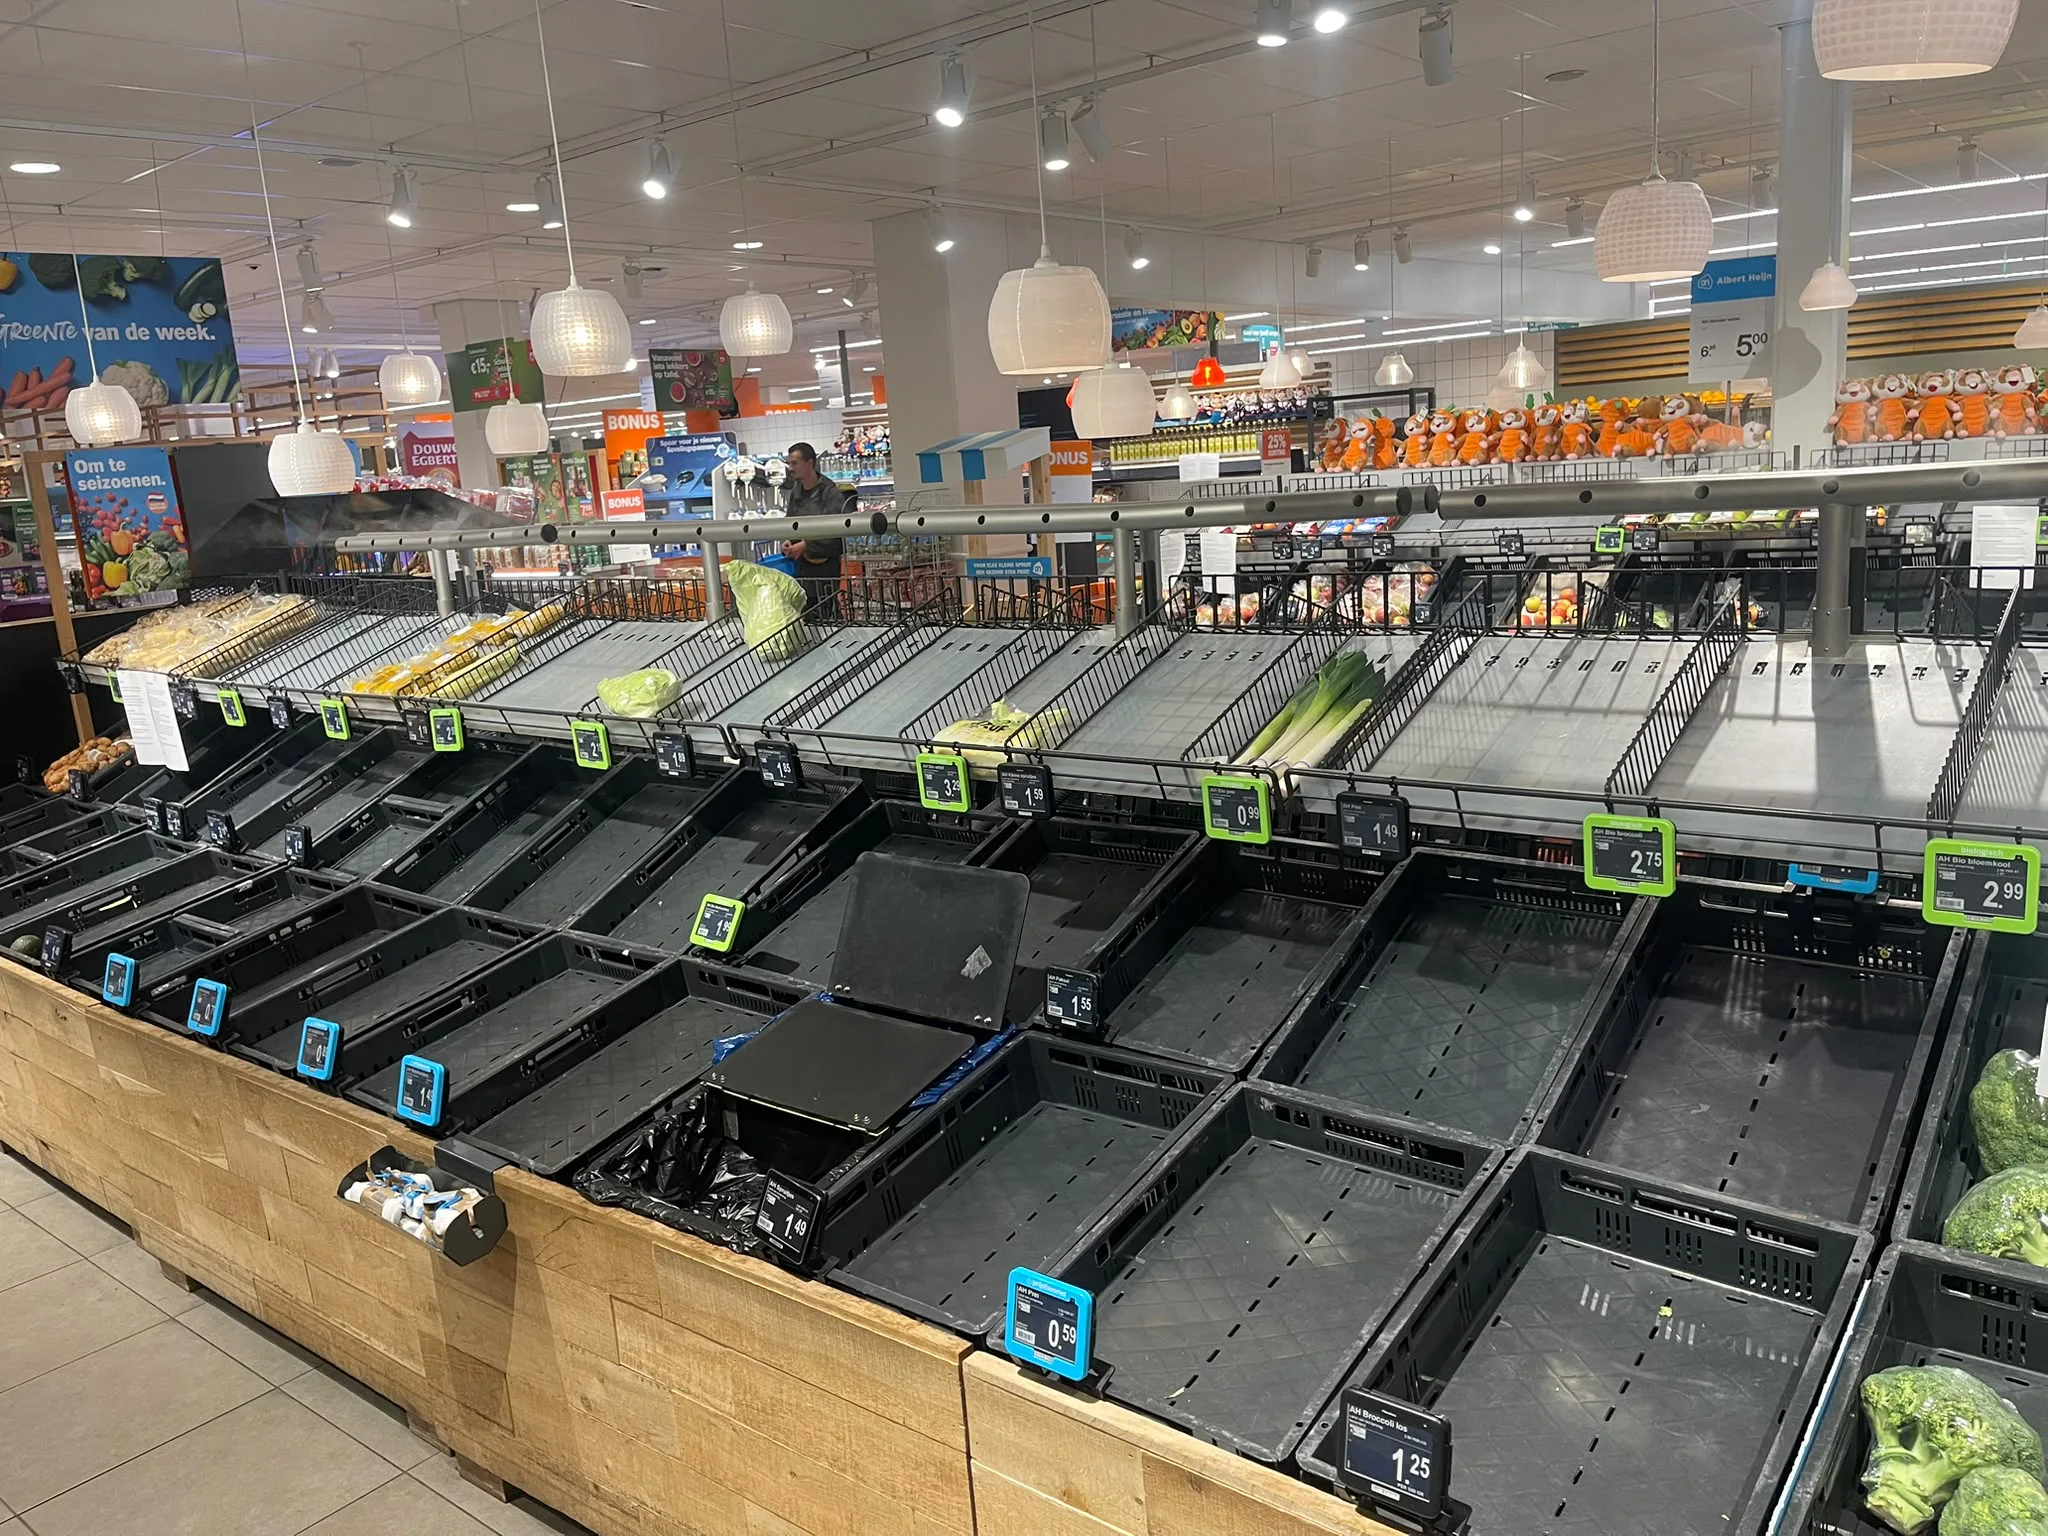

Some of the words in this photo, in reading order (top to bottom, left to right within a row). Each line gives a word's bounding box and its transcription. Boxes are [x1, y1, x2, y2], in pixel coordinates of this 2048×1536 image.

[1717, 275, 1745, 285] Albert
[1748, 272, 1773, 282] Heijn
[82, 326, 120, 341] van
[125, 322, 150, 341] de
[155, 323, 216, 341] week.
[607, 413, 660, 431] BONUS
[1267, 433, 1286, 449] 25%
[74, 459, 105, 473] Om
[108, 457, 127, 472] te
[412, 454, 457, 467] EGBERT
[1049, 450, 1088, 466] ONUS
[78, 475, 166, 491] seizoenen.
[607, 496, 641, 509] BONUS
[1960, 846, 2004, 857] biologisch
[1968, 858, 2011, 868] bloemkool
[1018, 1285, 1028, 1295] AH
[1349, 1406, 1361, 1416] AH
[1362, 1410, 1395, 1428] Broccoli
[1396, 1422, 1408, 1433] los
